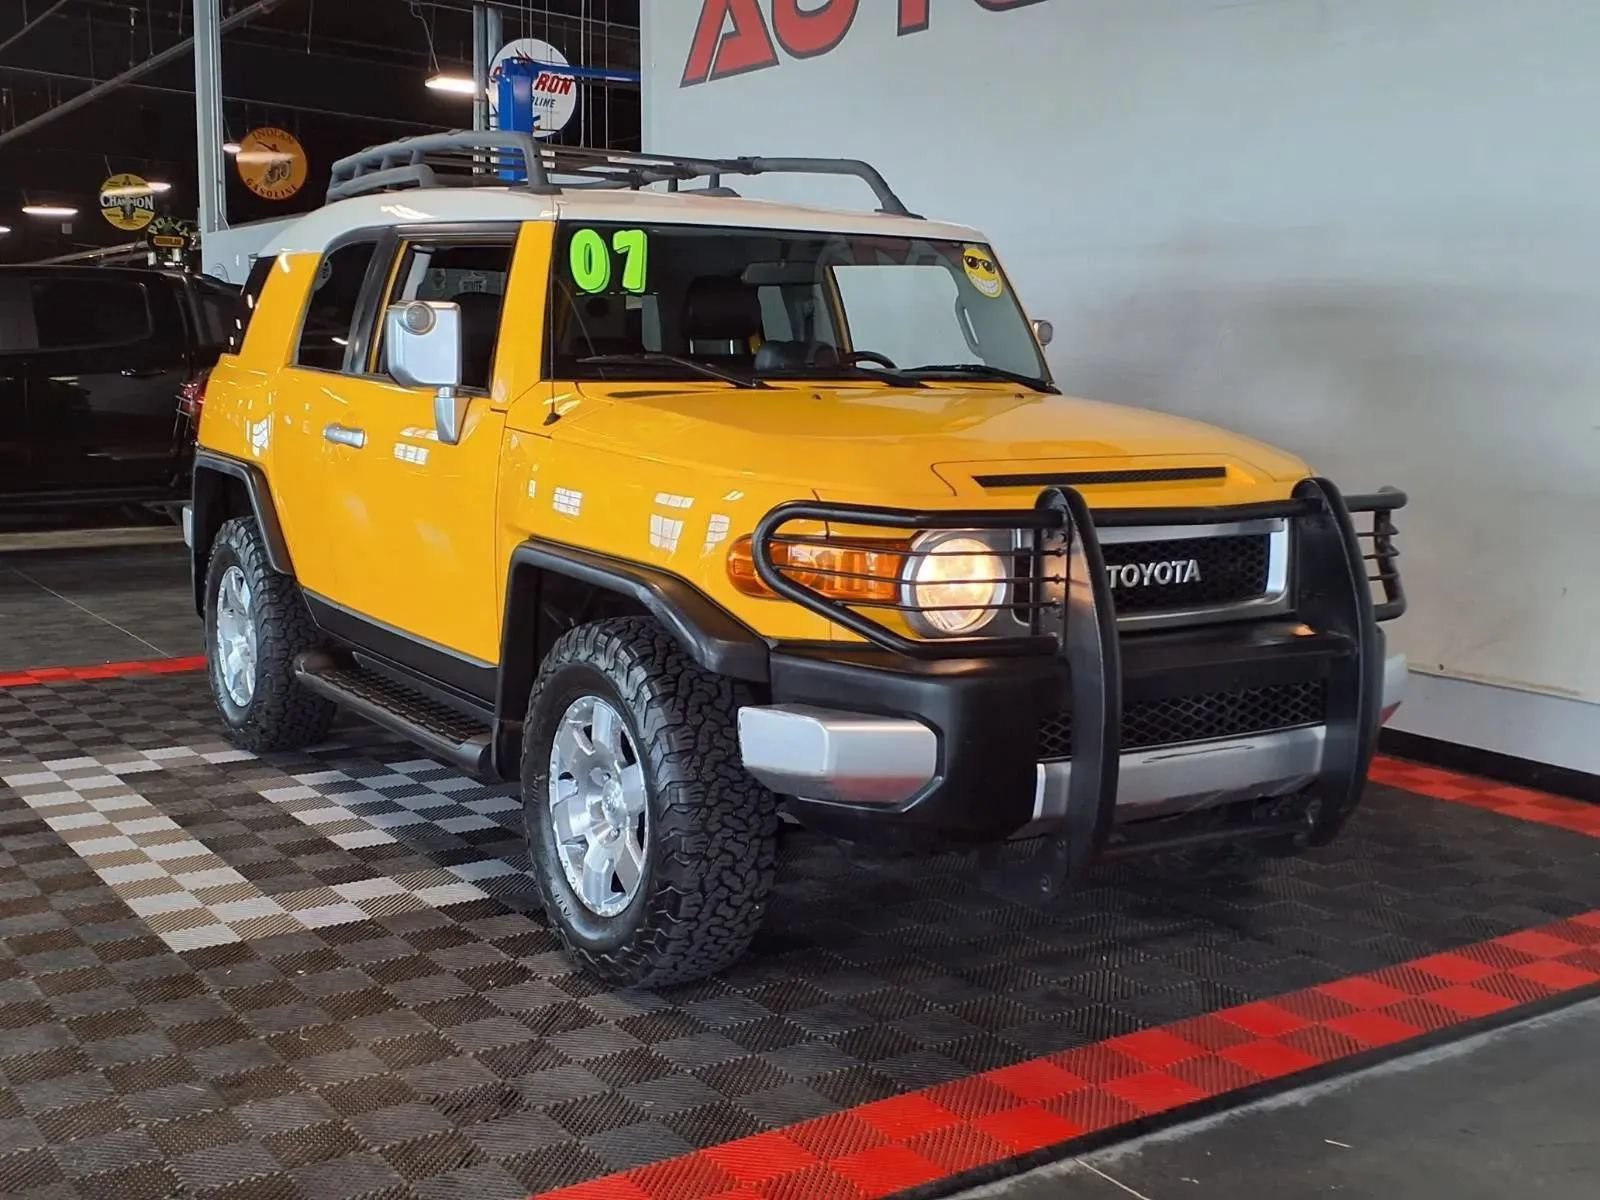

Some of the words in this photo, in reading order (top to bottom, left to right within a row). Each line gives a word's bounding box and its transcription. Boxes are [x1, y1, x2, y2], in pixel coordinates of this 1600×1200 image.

[679, 0, 1049, 89] AU
[252, 129, 294, 145] INDIAN
[569, 228, 648, 294] 07
[1106, 559, 1201, 588] TOYOTA
